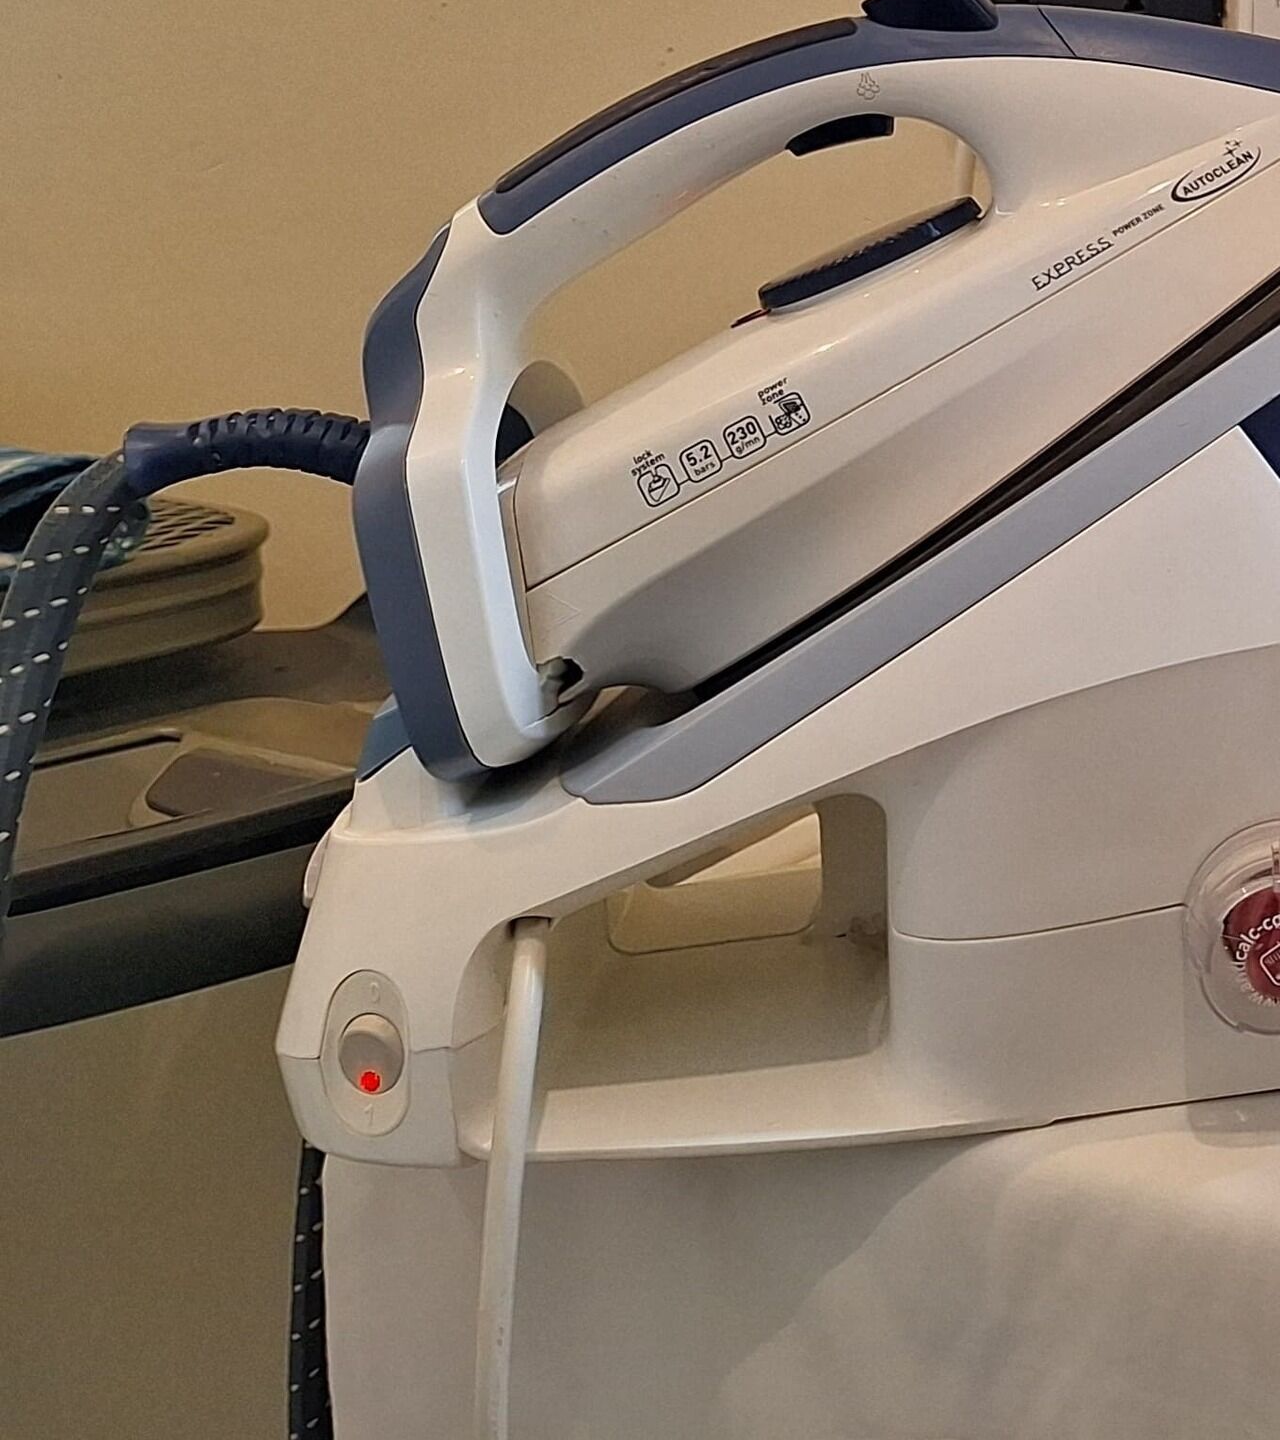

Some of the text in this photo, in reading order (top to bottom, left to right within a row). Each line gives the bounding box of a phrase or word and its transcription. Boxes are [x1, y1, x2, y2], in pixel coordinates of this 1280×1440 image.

[1181, 150, 1255, 197] AUTOCLEAN
[1031, 202, 1166, 292] EXPRESS POWER ZONE
[757, 376, 788, 400] power
[761, 388, 785, 406] zone
[726, 421, 758, 446] 230
[735, 435, 761, 455] g/mn
[630, 452, 666, 477] system
[633, 449, 653, 466] lock
[685, 444, 713, 467] 5.2
[693, 460, 716, 476] bars
